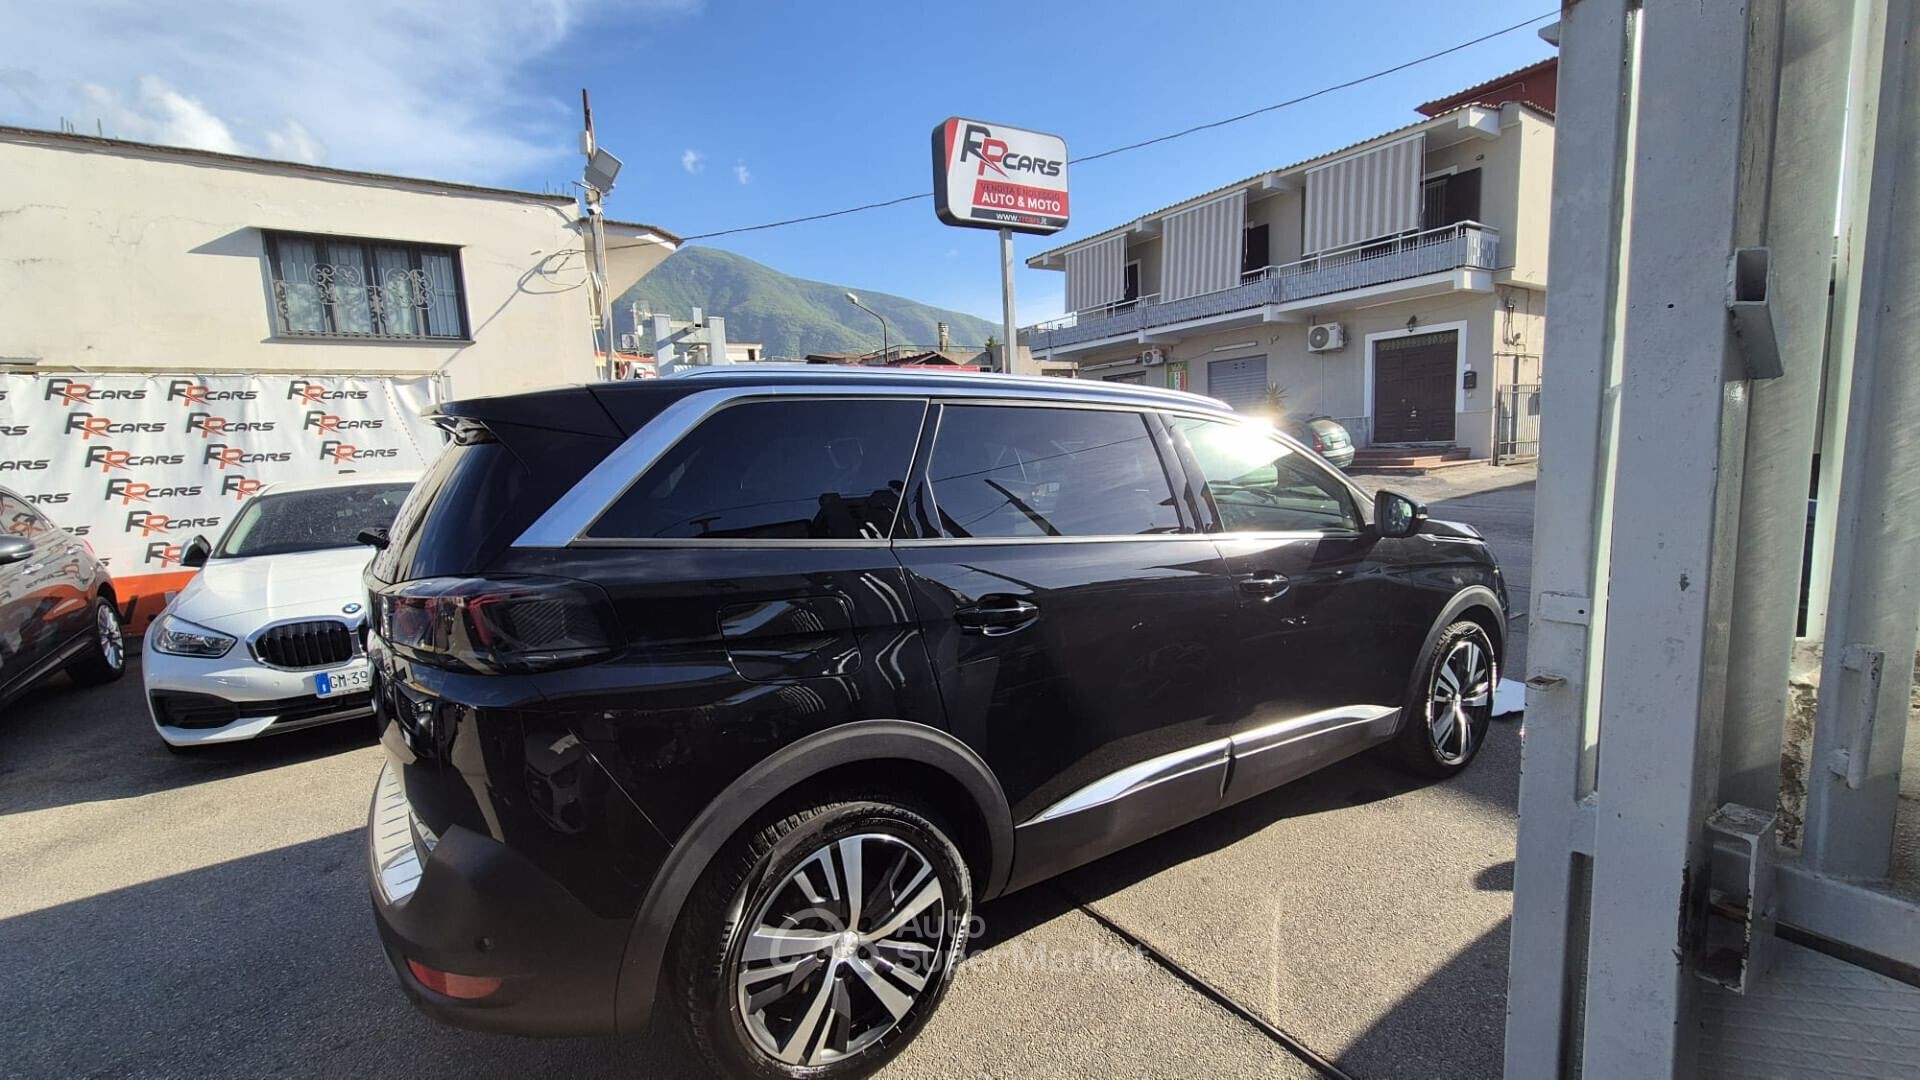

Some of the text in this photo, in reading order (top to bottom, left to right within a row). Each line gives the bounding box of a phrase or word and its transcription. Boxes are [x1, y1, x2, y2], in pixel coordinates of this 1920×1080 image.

[1003, 152, 1063, 177] CARS
[981, 191, 1061, 212] AUTO & MOTO
[0, 459, 51, 471] ARS
